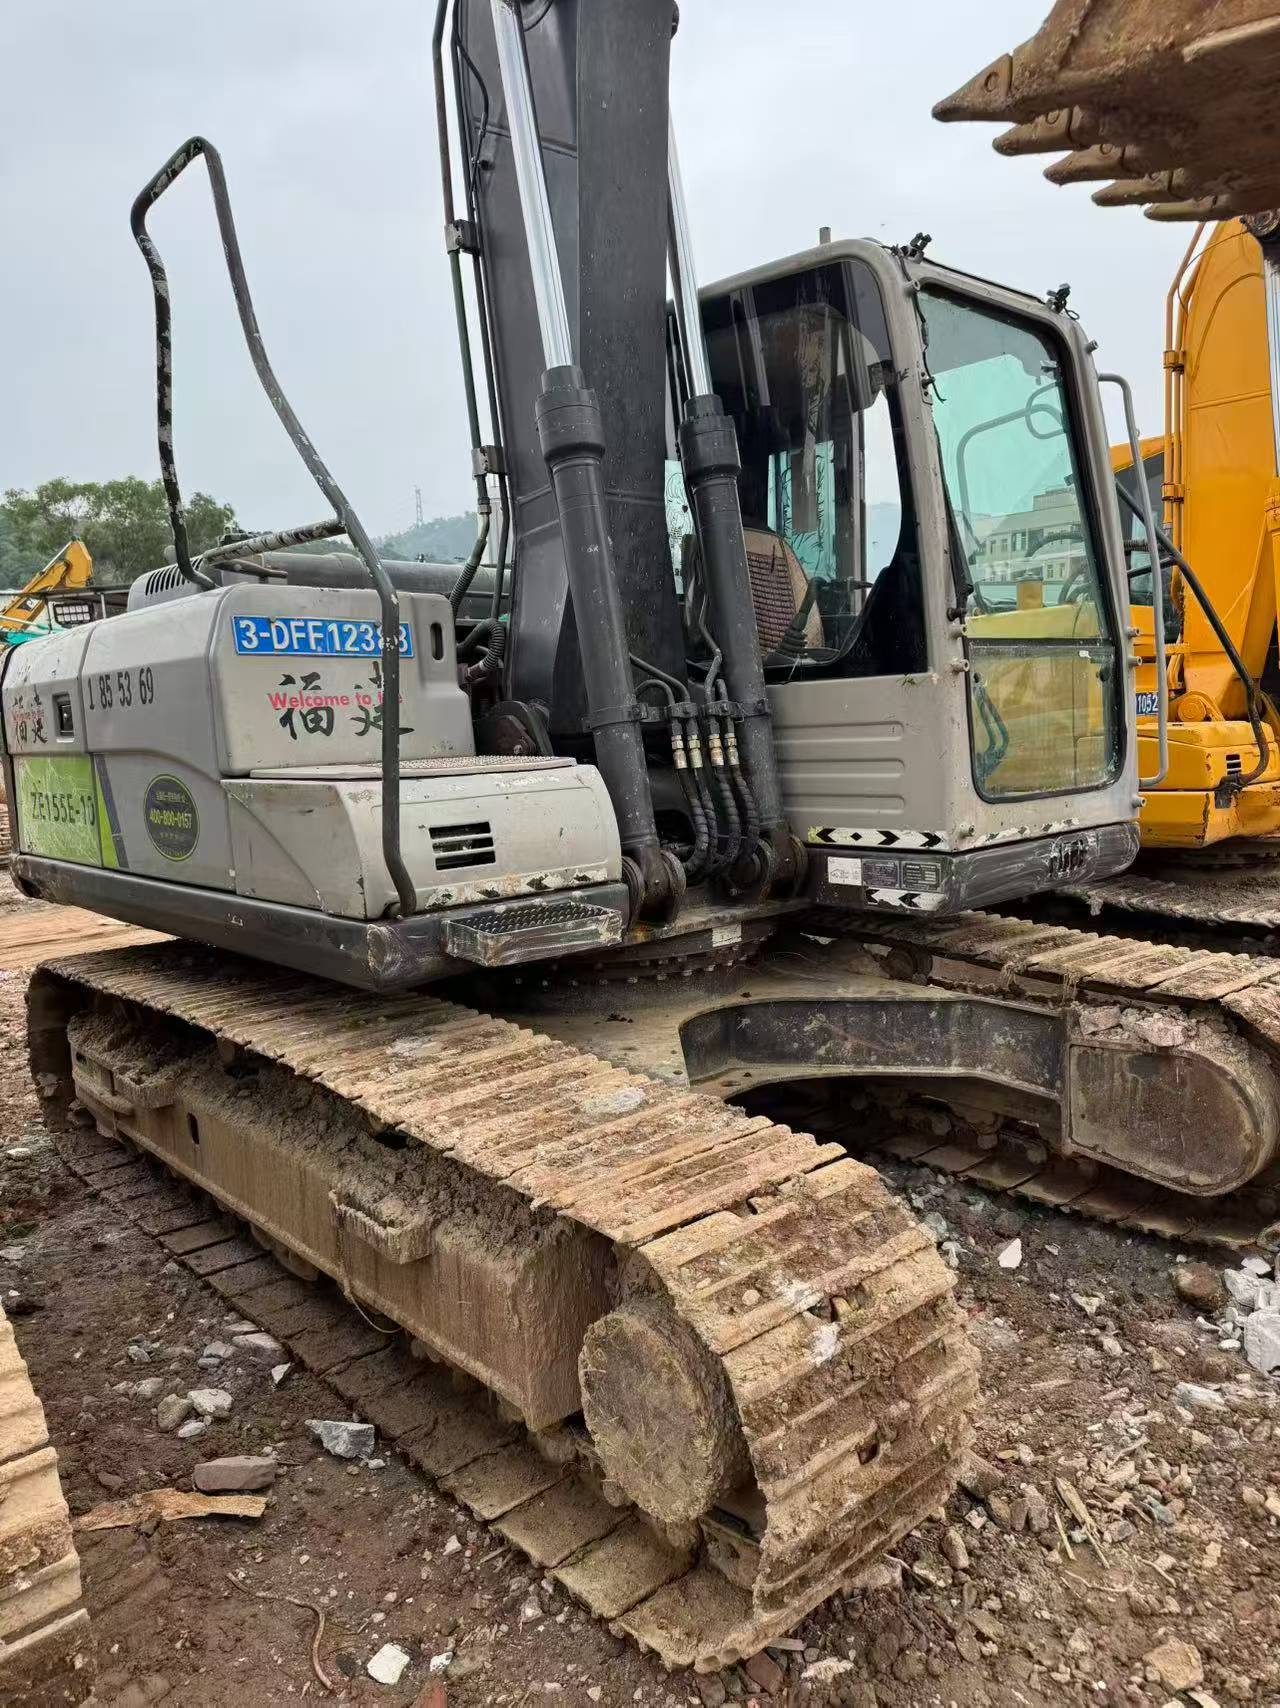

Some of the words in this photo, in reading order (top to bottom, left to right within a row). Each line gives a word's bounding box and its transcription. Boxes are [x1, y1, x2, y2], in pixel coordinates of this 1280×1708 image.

[99, 674, 113, 709] 85
[117, 671, 132, 706] 53
[139, 667, 154, 704] 69
[267, 691, 349, 711] Welcome
[355, 692, 372, 706] to
